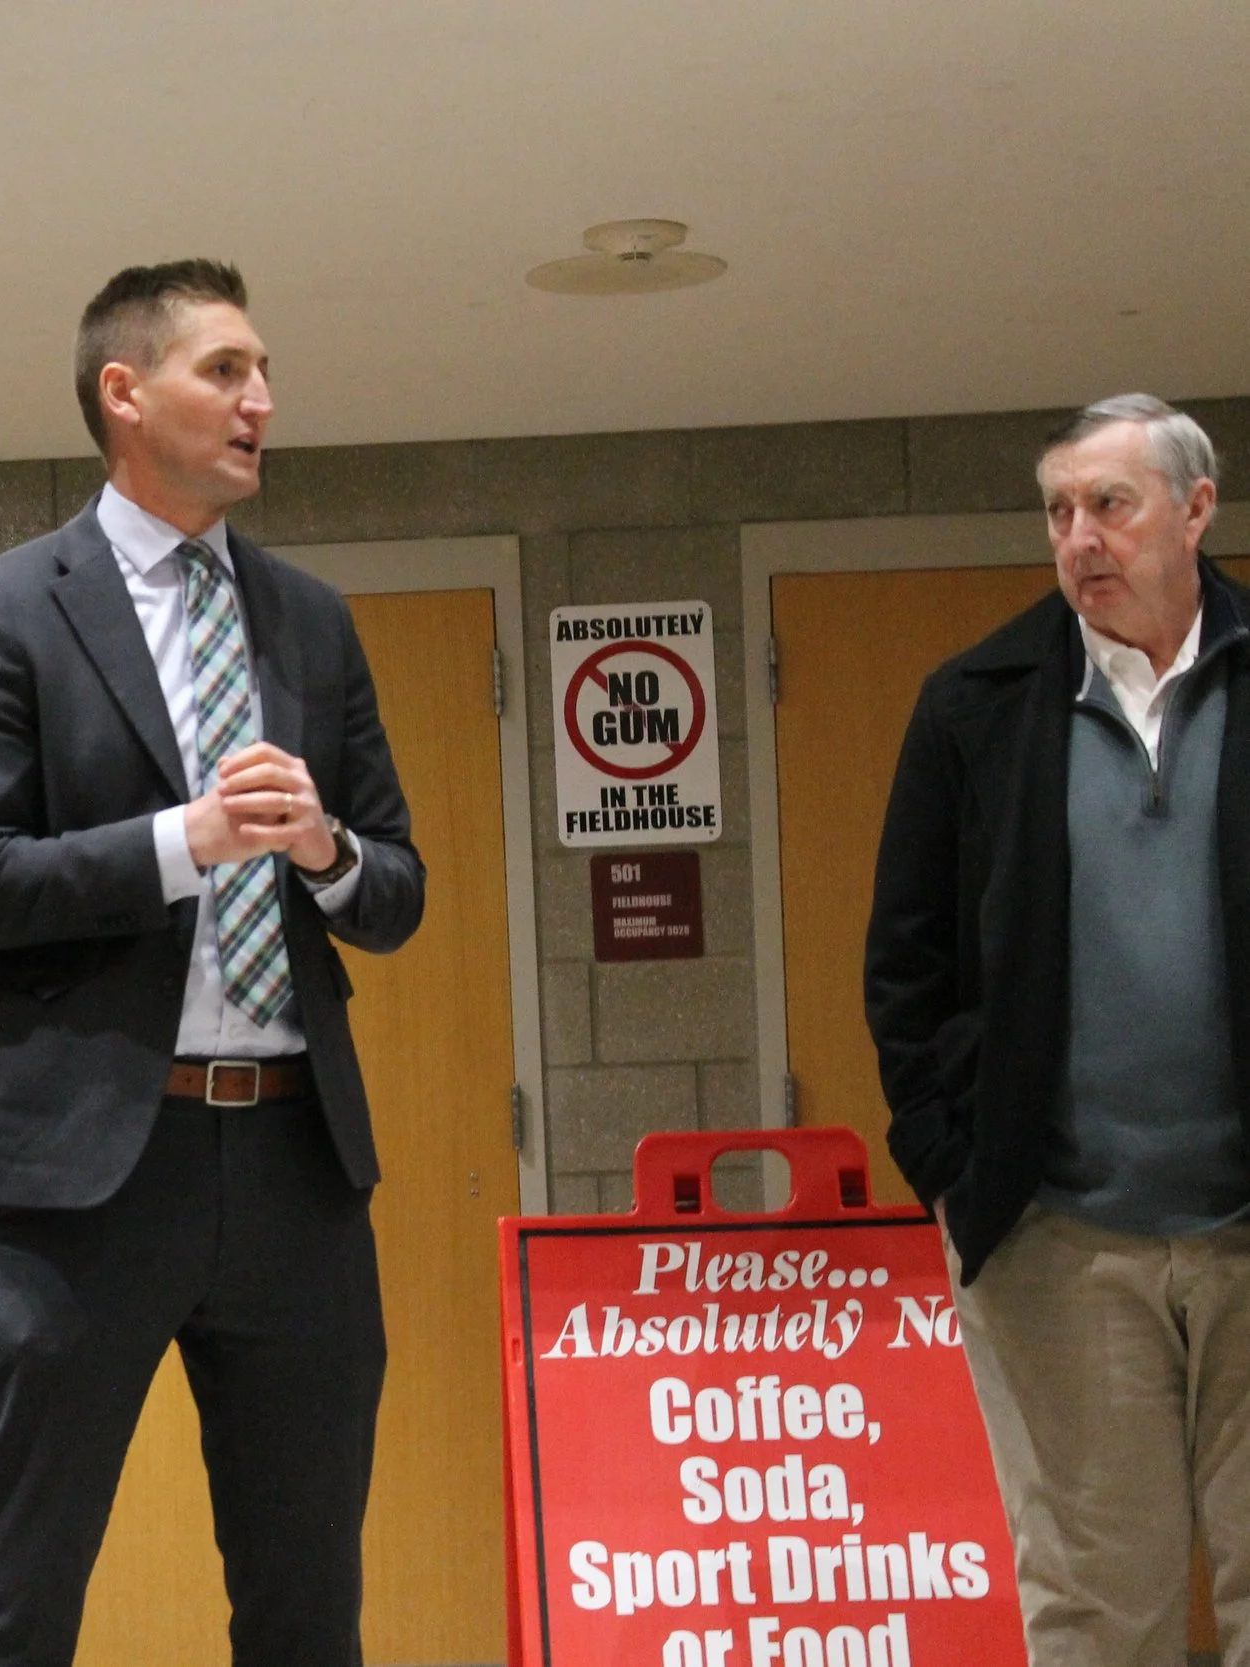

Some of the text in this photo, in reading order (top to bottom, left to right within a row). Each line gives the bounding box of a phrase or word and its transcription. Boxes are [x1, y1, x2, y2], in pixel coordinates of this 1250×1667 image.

[556, 613, 704, 641] ABSOLUTELY
[607, 670, 659, 707] NO
[592, 708, 680, 746] GUM
[600, 784, 679, 808] IN THE
[566, 805, 716, 833] FIELDHOUSE
[611, 863, 641, 883] 501
[612, 894, 672, 908] FIELDHOUSE
[613, 916, 656, 927] MAXIMUM
[614, 926, 665, 938] OCCUPANCY
[633, 1243, 889, 1295] Please...
[540, 1295, 963, 1360] Absolutely No
[649, 1375, 881, 1445] Coffee,
[679, 1454, 863, 1526] Soda,
[568, 1532, 990, 1615] Sport Drinks
[662, 1613, 911, 1667] or Food
